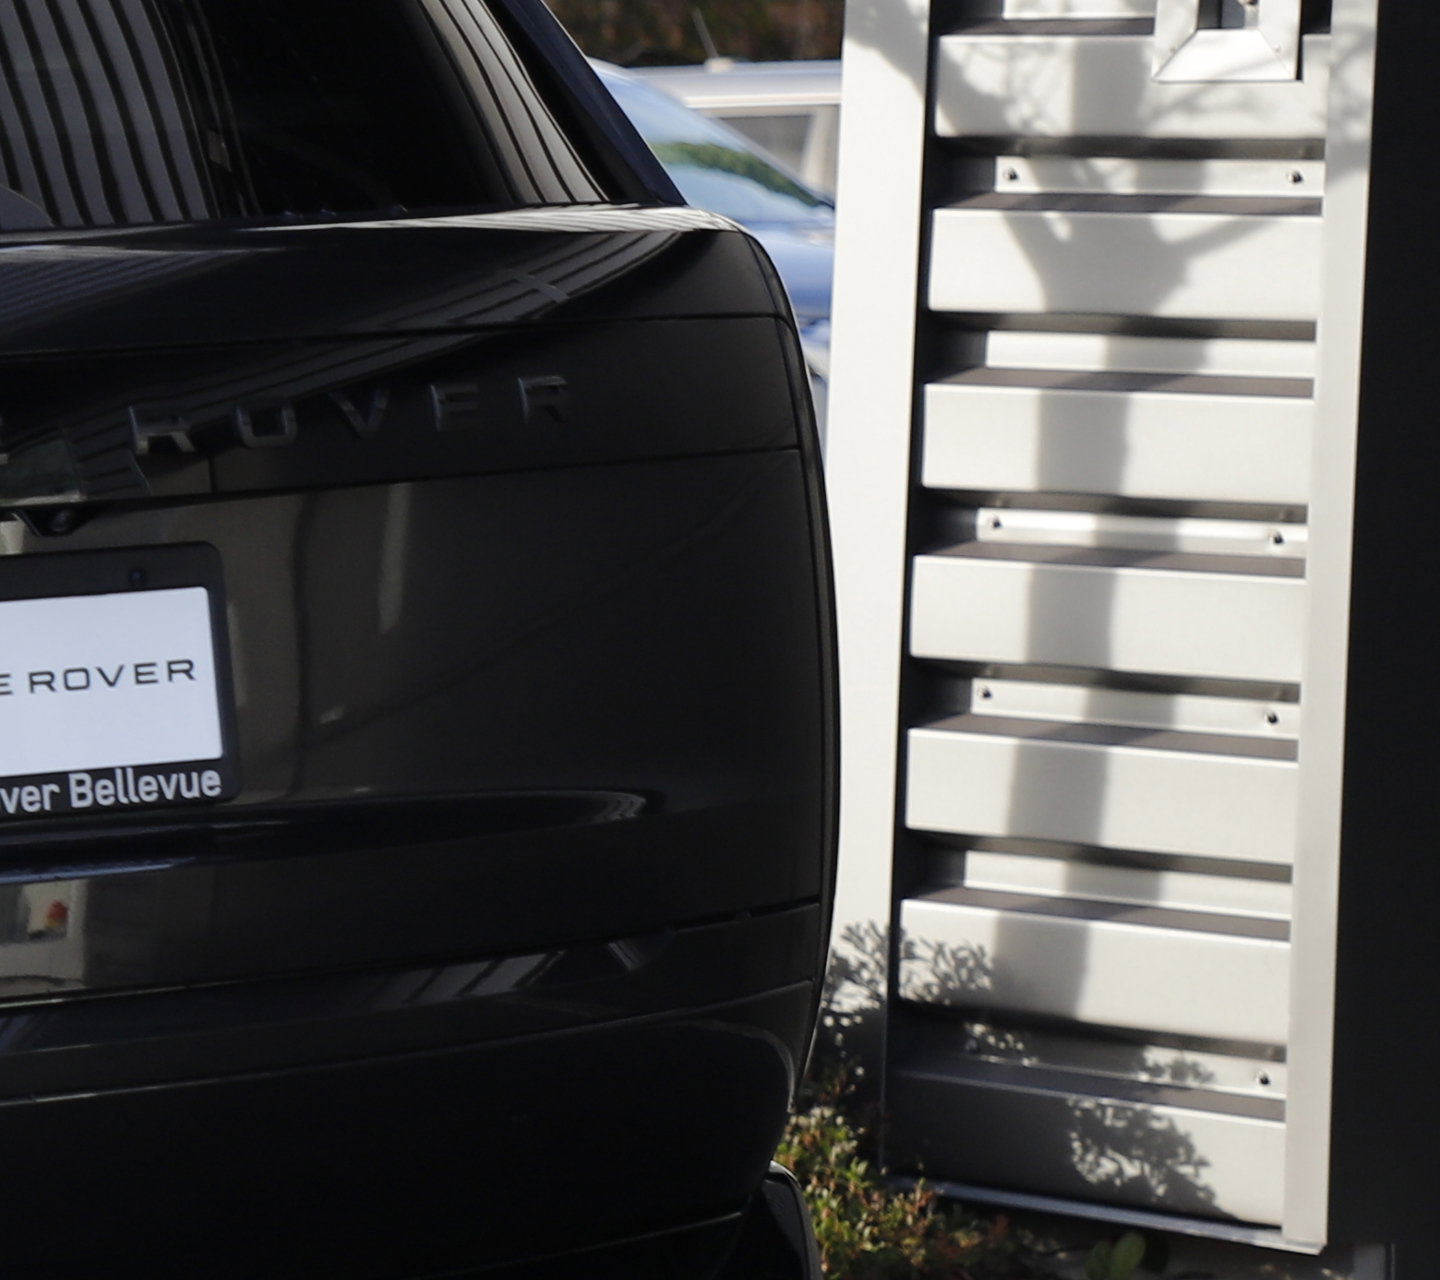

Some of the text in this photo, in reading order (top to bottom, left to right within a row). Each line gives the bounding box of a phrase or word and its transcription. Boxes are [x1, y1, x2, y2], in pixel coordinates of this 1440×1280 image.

[128, 375, 567, 456] ROVER
[28, 659, 197, 694] ROVER
[68, 767, 222, 808] Bellevue
